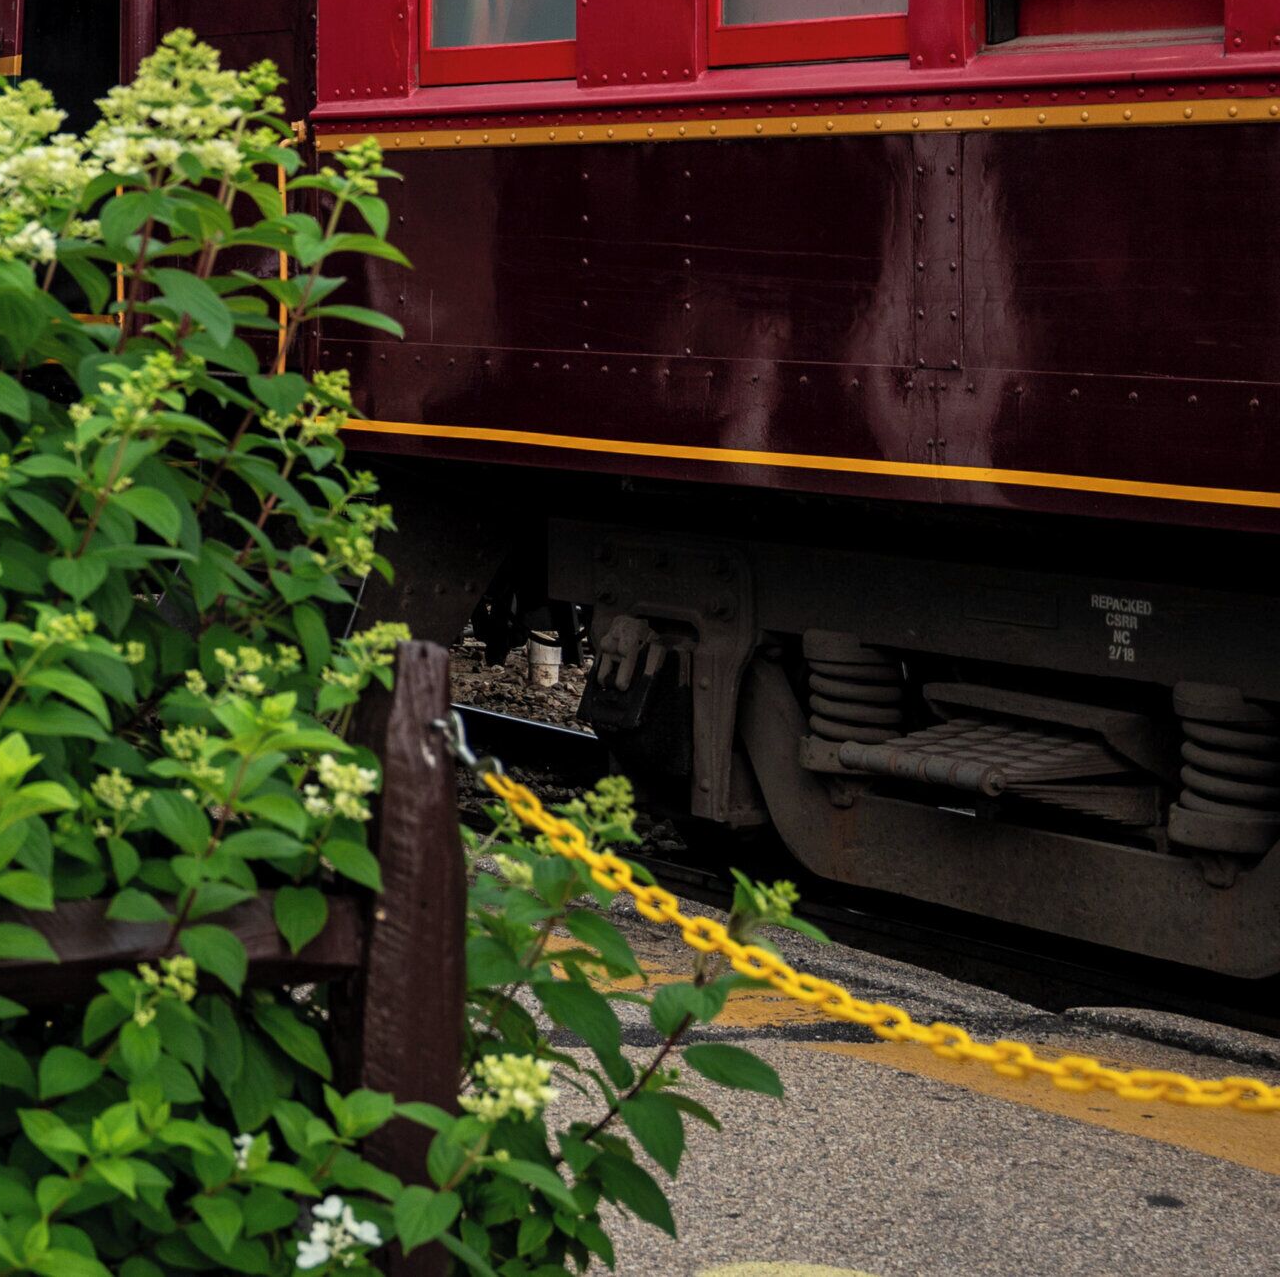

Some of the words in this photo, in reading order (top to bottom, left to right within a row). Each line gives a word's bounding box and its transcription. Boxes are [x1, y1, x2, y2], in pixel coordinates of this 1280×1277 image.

[1091, 594, 1152, 616] REPACKED
[1105, 612, 1138, 630] CSRR
[1113, 630, 1131, 645] NC
